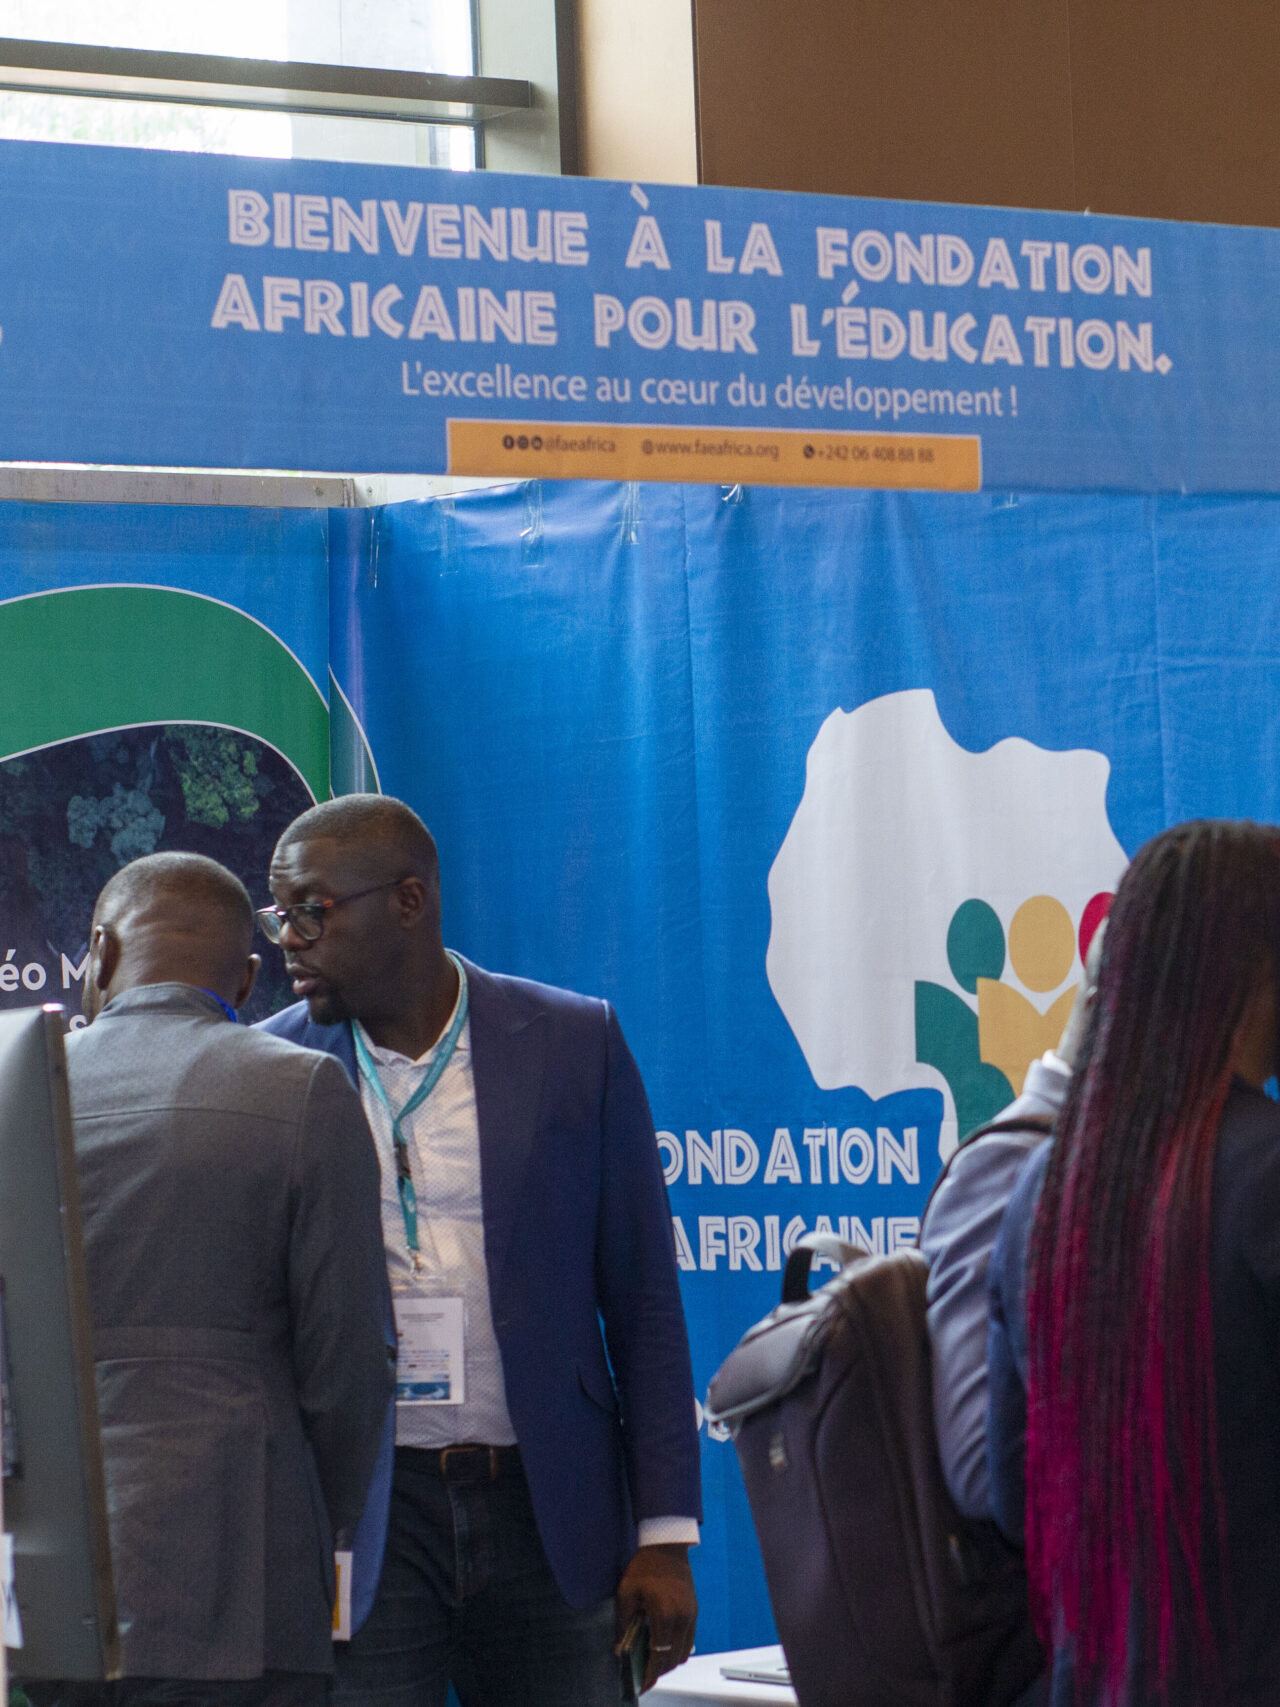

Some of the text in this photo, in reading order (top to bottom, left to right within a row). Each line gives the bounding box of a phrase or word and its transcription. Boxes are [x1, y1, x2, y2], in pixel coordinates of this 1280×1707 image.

[228, 182, 1152, 297] BIENVENUE À LA FONDATION
[211, 273, 1173, 376] AFRICAINE POUR L'ÉDUCATION.
[402, 361, 587, 400] L'excellence
[596, 376, 632, 403] au
[640, 378, 720, 405] cœur
[727, 372, 767, 407] du
[774, 374, 1004, 420] développement
[61, 951, 92, 989] M
[655, 1126, 920, 1186] ONDATION
